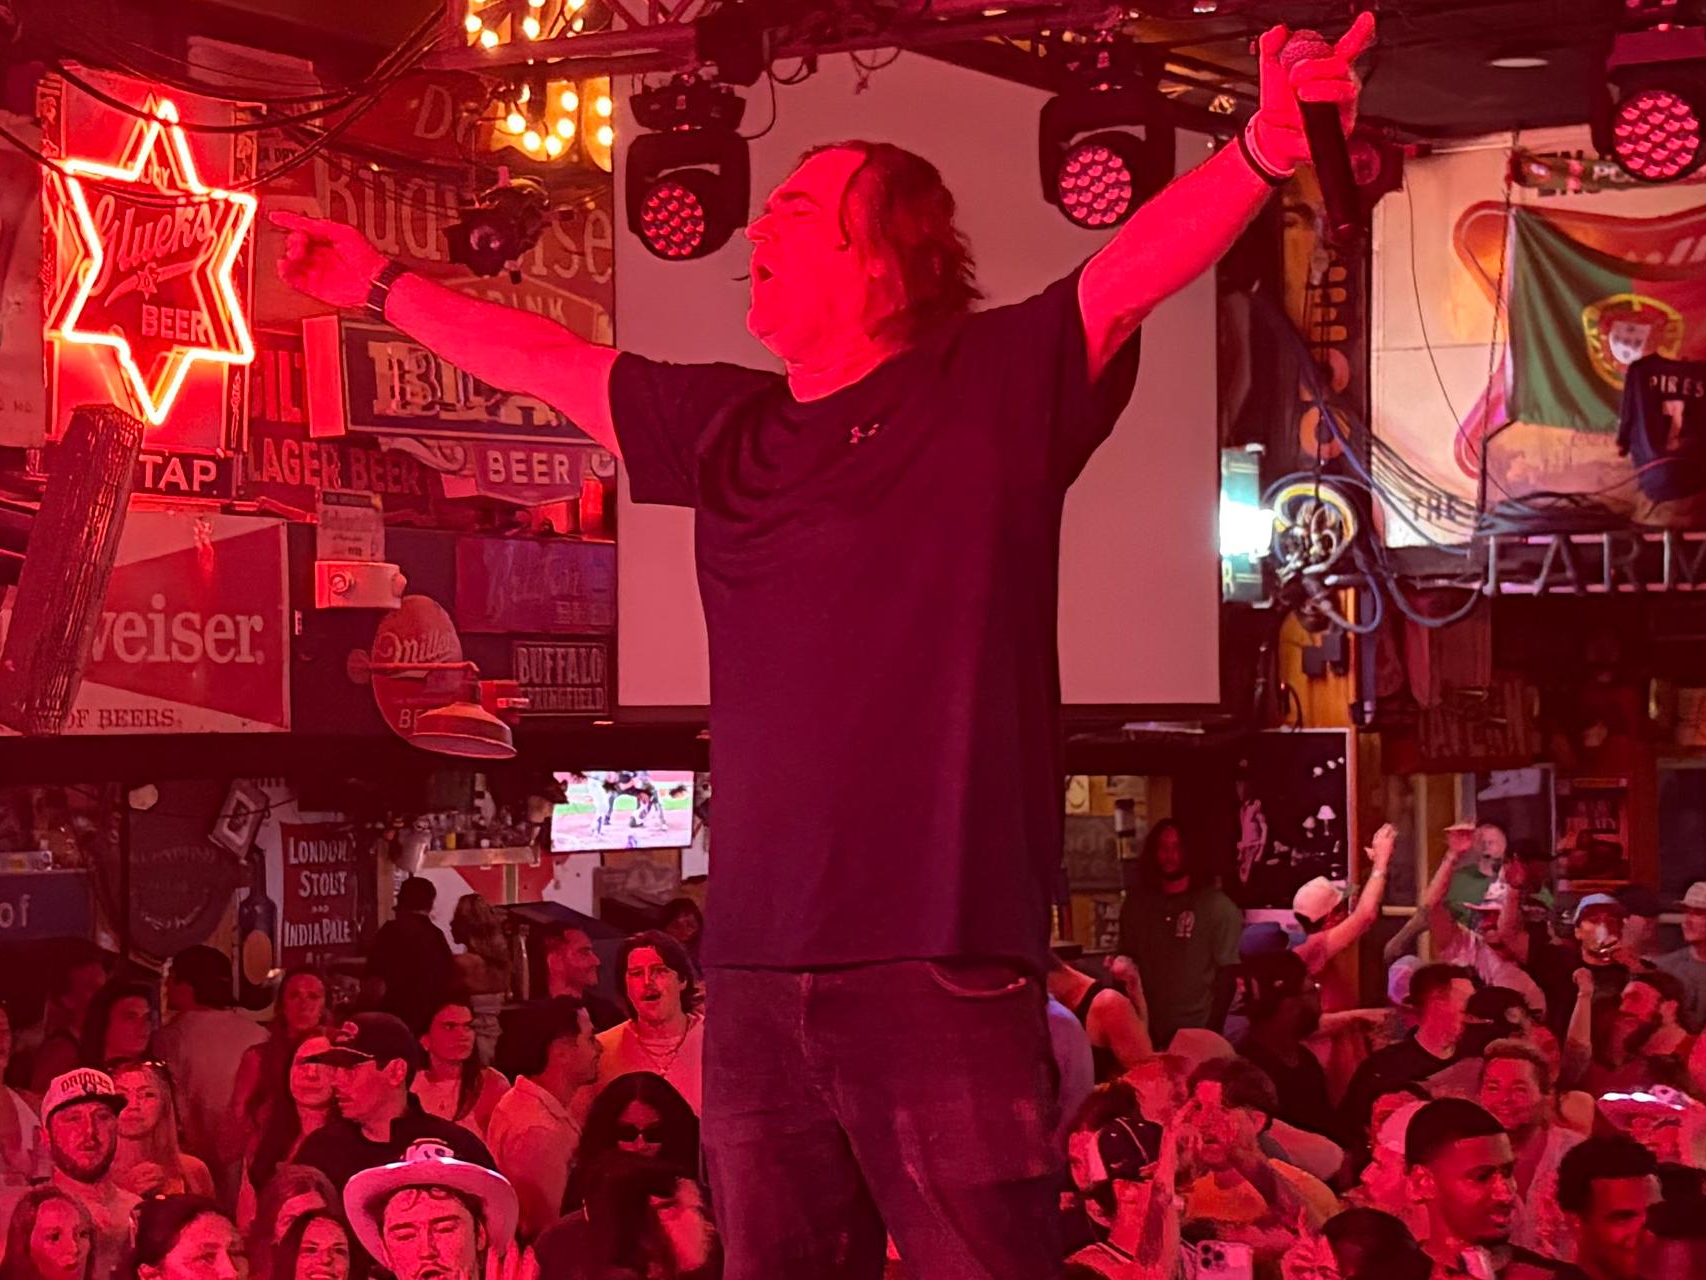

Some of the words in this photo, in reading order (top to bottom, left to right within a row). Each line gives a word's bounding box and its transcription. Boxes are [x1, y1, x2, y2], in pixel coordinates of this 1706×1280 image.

[142, 304, 210, 344] BEER
[1647, 373, 1706, 397] PIRES
[138, 454, 217, 492] TAP
[247, 431, 341, 490] LAGER
[486, 449, 572, 486] BEER
[518, 645, 605, 685] BUFFALO
[298, 871, 347, 898] STOUT
[284, 923, 322, 947] INDIA
[322, 919, 351, 945] PALE
